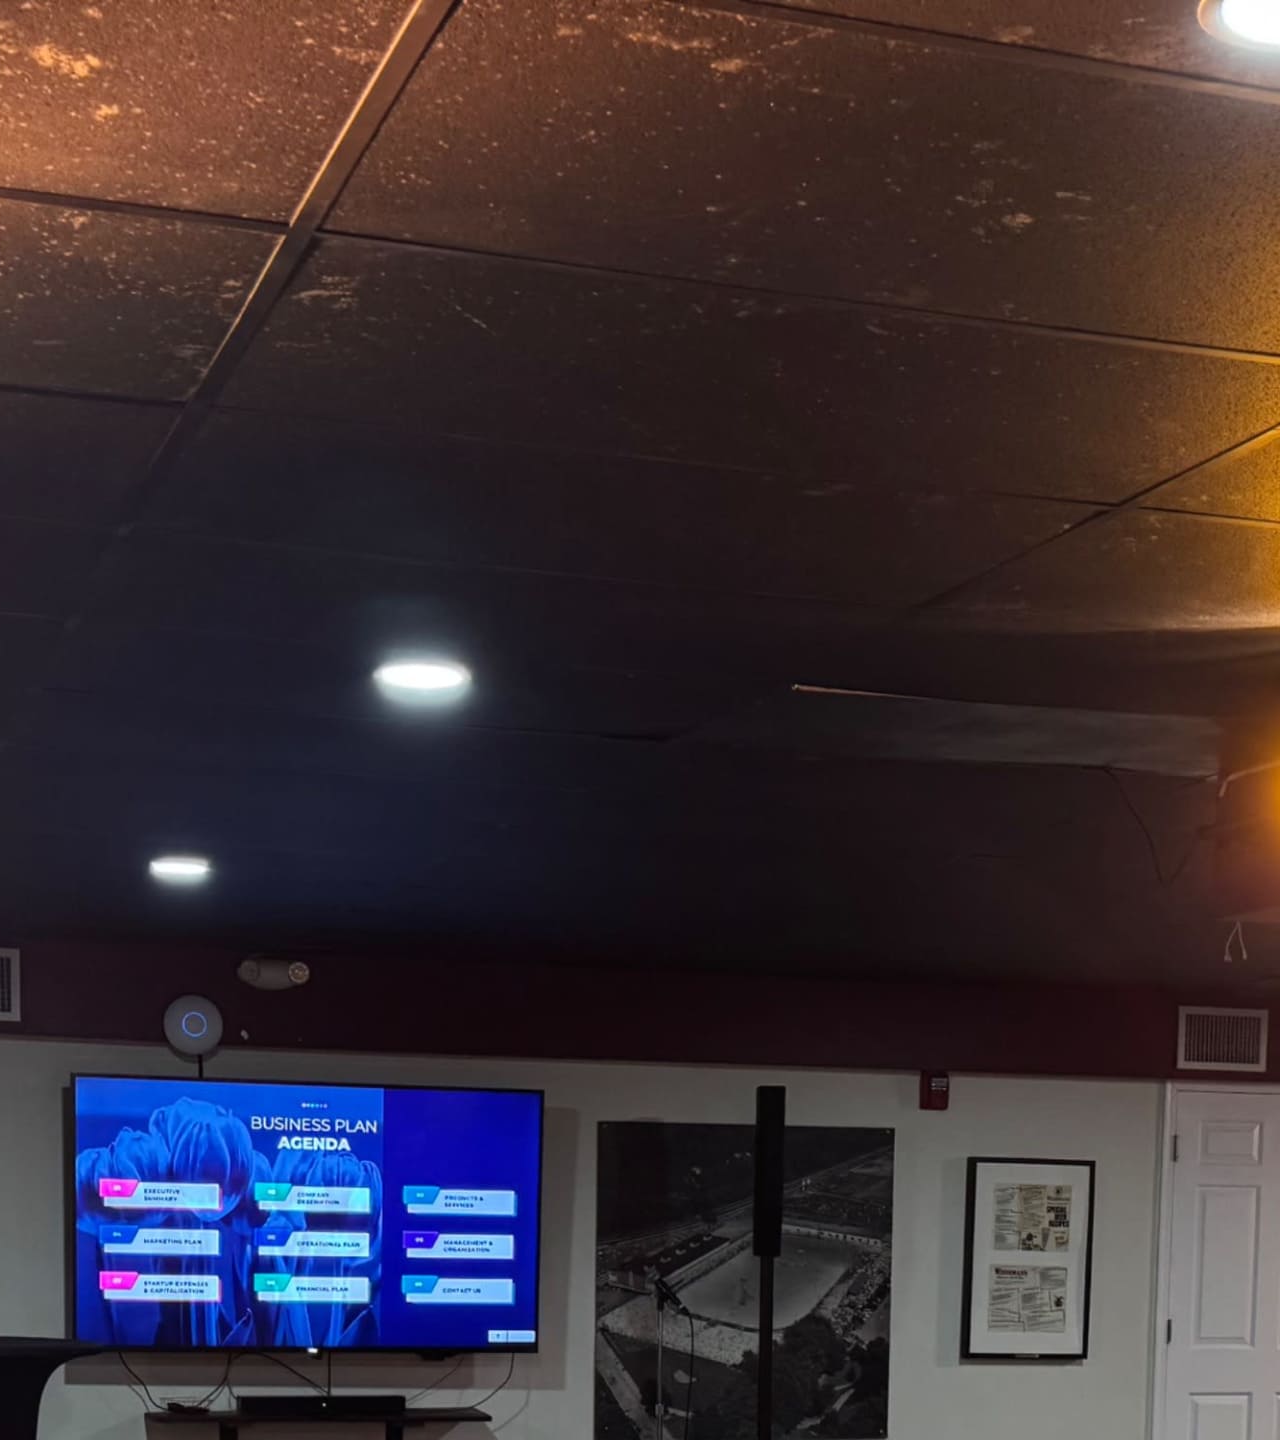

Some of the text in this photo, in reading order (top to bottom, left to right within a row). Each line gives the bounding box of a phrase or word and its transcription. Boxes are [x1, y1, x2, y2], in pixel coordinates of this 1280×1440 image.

[250, 1115, 378, 1134] BUSINESS PLAN
[277, 1136, 351, 1152] AGENDA
